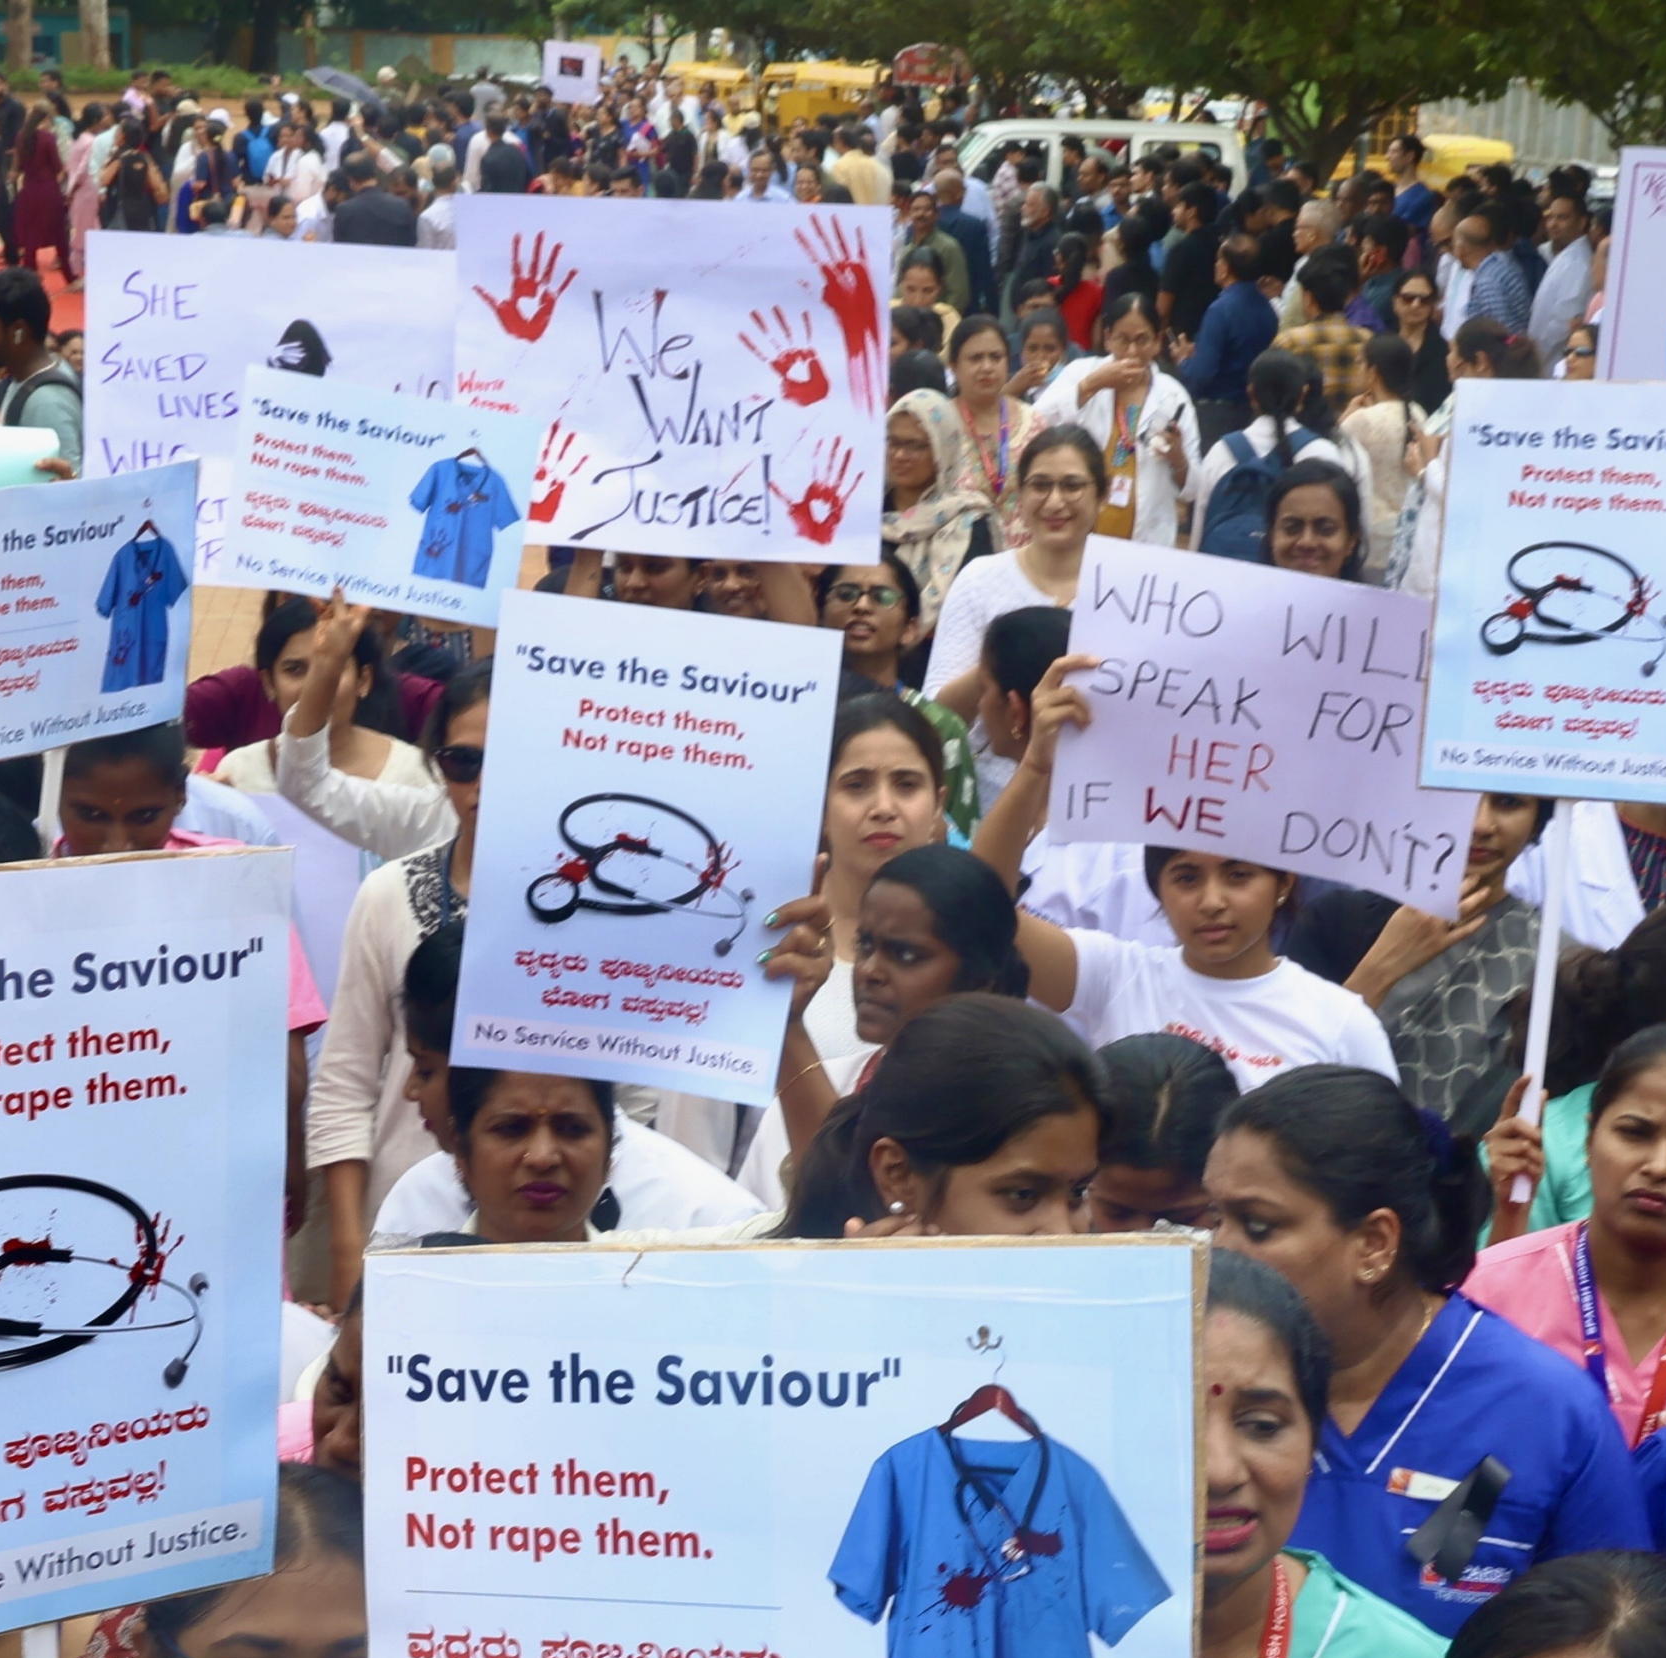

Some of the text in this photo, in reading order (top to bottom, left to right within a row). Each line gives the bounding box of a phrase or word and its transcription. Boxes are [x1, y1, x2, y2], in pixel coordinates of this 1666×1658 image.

[111, 269, 200, 328] SHE
[101, 343, 209, 384] SAVED
[158, 391, 240, 419] LIVES
[254, 399, 445, 447] "Save the Saviour"
[629, 361, 775, 447] WANT
[252, 452, 279, 467] Not
[325, 468, 365, 485] them.
[254, 433, 355, 466] Protect them,
[3, 530, 36, 552] the
[43, 516, 123, 547] Saviour"
[1, 575, 45, 590] them,
[15, 597, 58, 612] them.
[1092, 562, 1226, 639] WHO
[517, 646, 816, 703] "Save the Saviour"
[579, 699, 744, 740] Protect them,
[1089, 657, 1414, 756] SPEAK FOR
[563, 728, 752, 770] Not rape them.
[1169, 733, 1276, 793] HER
[1066, 781, 1111, 820] IF
[1142, 787, 1226, 838] WE
[72, 937, 262, 993] Saviour"
[67, 1025, 170, 1058] them,
[475, 1024, 752, 1073] No Service Without Justice.
[86, 1072, 186, 1104] them.
[388, 1353, 900, 1407] "Save the Saviour"
[407, 1457, 668, 1504] Protect them,
[15, 1539, 135, 1583] Without
[144, 1521, 259, 1563] Justice.
[407, 1513, 712, 1562] Not rape them.
